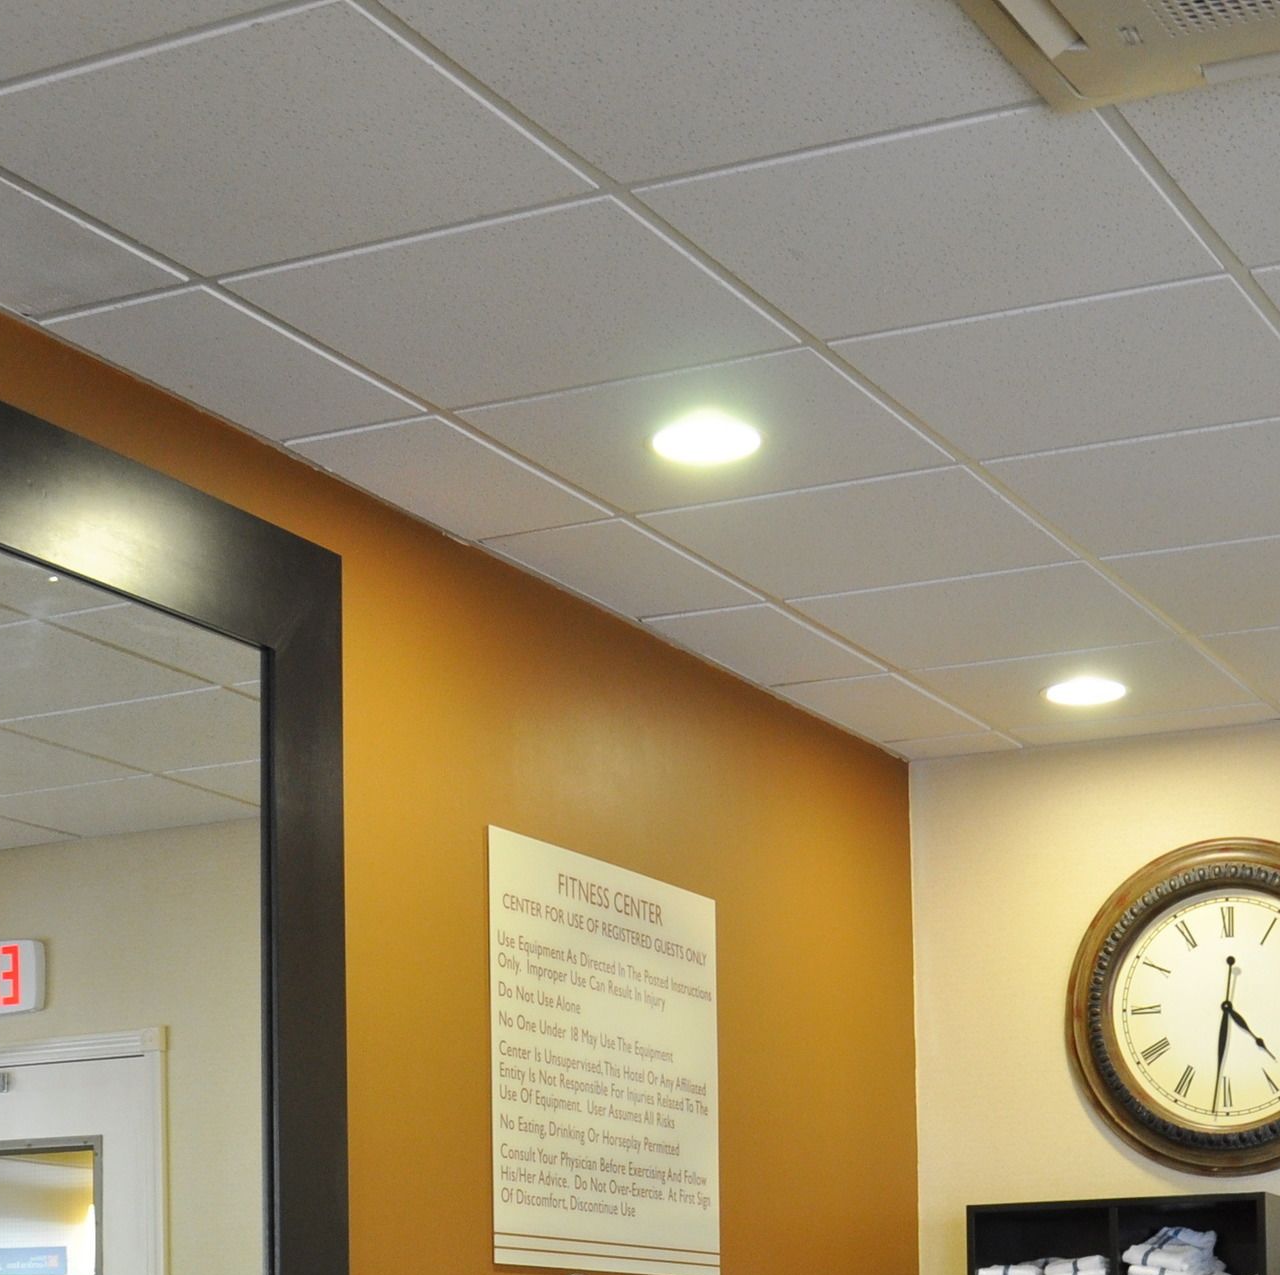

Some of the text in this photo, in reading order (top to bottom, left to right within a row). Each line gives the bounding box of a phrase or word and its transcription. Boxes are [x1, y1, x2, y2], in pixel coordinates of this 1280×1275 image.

[558, 874, 663, 926] FITNESS CENTER
[503, 893, 707, 967] CENTER FOR USE OF REGISTERED GUESTS ONLY
[497, 929, 712, 1002] Use Equipment As Directed In The Posted Instructions
[498, 952, 666, 1012] Only. Improper Use Can Result In Injury
[498, 981, 581, 1014] Do Not Use Alone
[499, 1010, 673, 1063] No One Under 18 May Use The Equipment
[499, 1040, 531, 1060] Center
[534, 1046, 542, 1066] Is
[604, 1061, 621, 1081] This
[623, 1065, 645, 1083] Hotel
[647, 1070, 658, 1088] Or
[660, 1074, 674, 1092] Any
[675, 1077, 706, 1098] Affiliated
[499, 1061, 709, 1116] Entity Is Not Responsible For Injuries Related To The
[500, 1084, 518, 1102] Use
[520, 1088, 533, 1104] Of
[587, 1099, 606, 1118] User
[608, 1104, 642, 1124] Assumes
[644, 1110, 654, 1125] All
[657, 1112, 675, 1129] Risks
[500, 1113, 680, 1156] No Eating, Drinking Or Horseplay Permitted
[500, 1143, 707, 1187] Consult Your Physician Before Exercising And Follow
[500, 1164, 536, 1187] His/Her
[538, 1170, 570, 1192] Advice.
[574, 1174, 588, 1192] Do
[590, 1177, 607, 1193] Not
[668, 1187, 677, 1203] At
[679, 1188, 695, 1205] First
[697, 1191, 711, 1210] Sign
[501, 1187, 514, 1203] Of
[570, 1195, 619, 1215] Discontinue
[620, 1201, 636, 1217] Use
